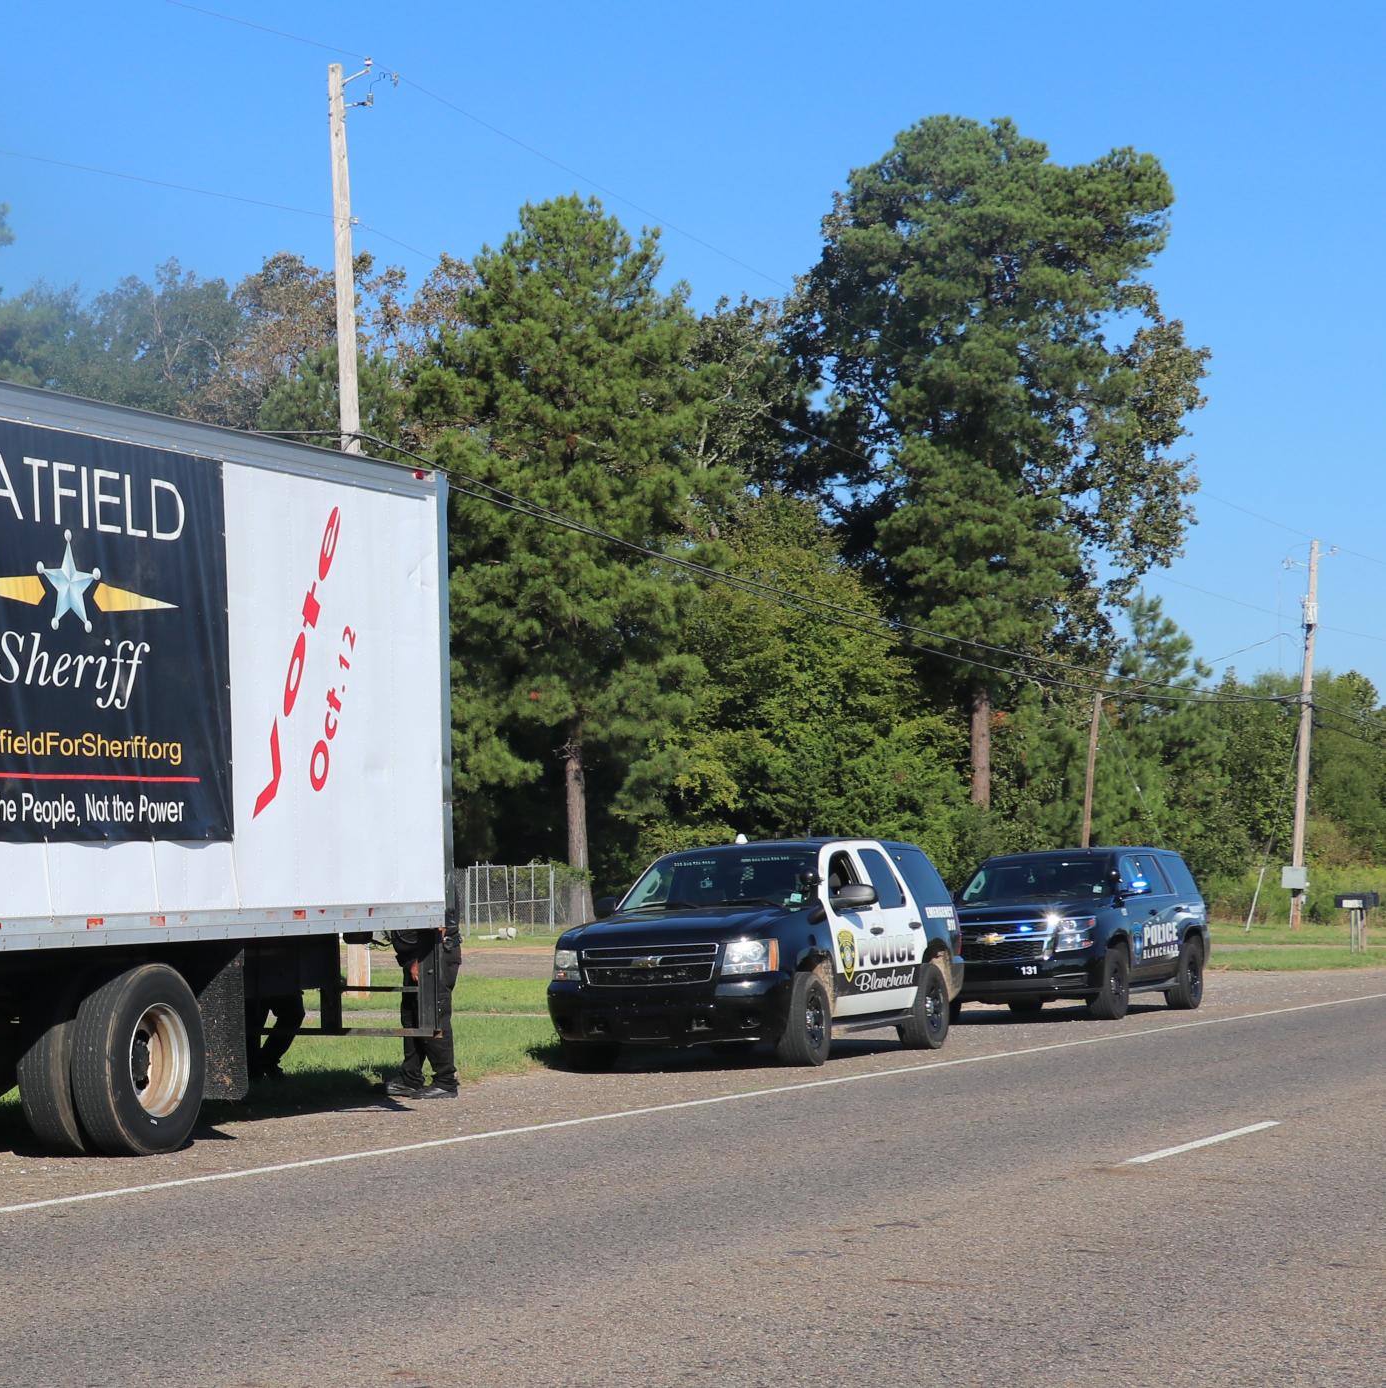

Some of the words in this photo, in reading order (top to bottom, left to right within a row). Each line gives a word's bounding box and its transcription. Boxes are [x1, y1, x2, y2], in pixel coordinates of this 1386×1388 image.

[252, 505, 341, 820] Vote
[310, 684, 346, 792] Oct.
[339, 625, 356, 670] 12
[21, 792, 81, 829] People,
[85, 793, 108, 822] Not
[112, 794, 134, 822] the
[138, 794, 185, 823] Power
[858, 934, 915, 967] POLICE
[1143, 921, 1179, 947] POLICE
[854, 967, 915, 992] Blanchard
[1021, 965, 1038, 975] 131
